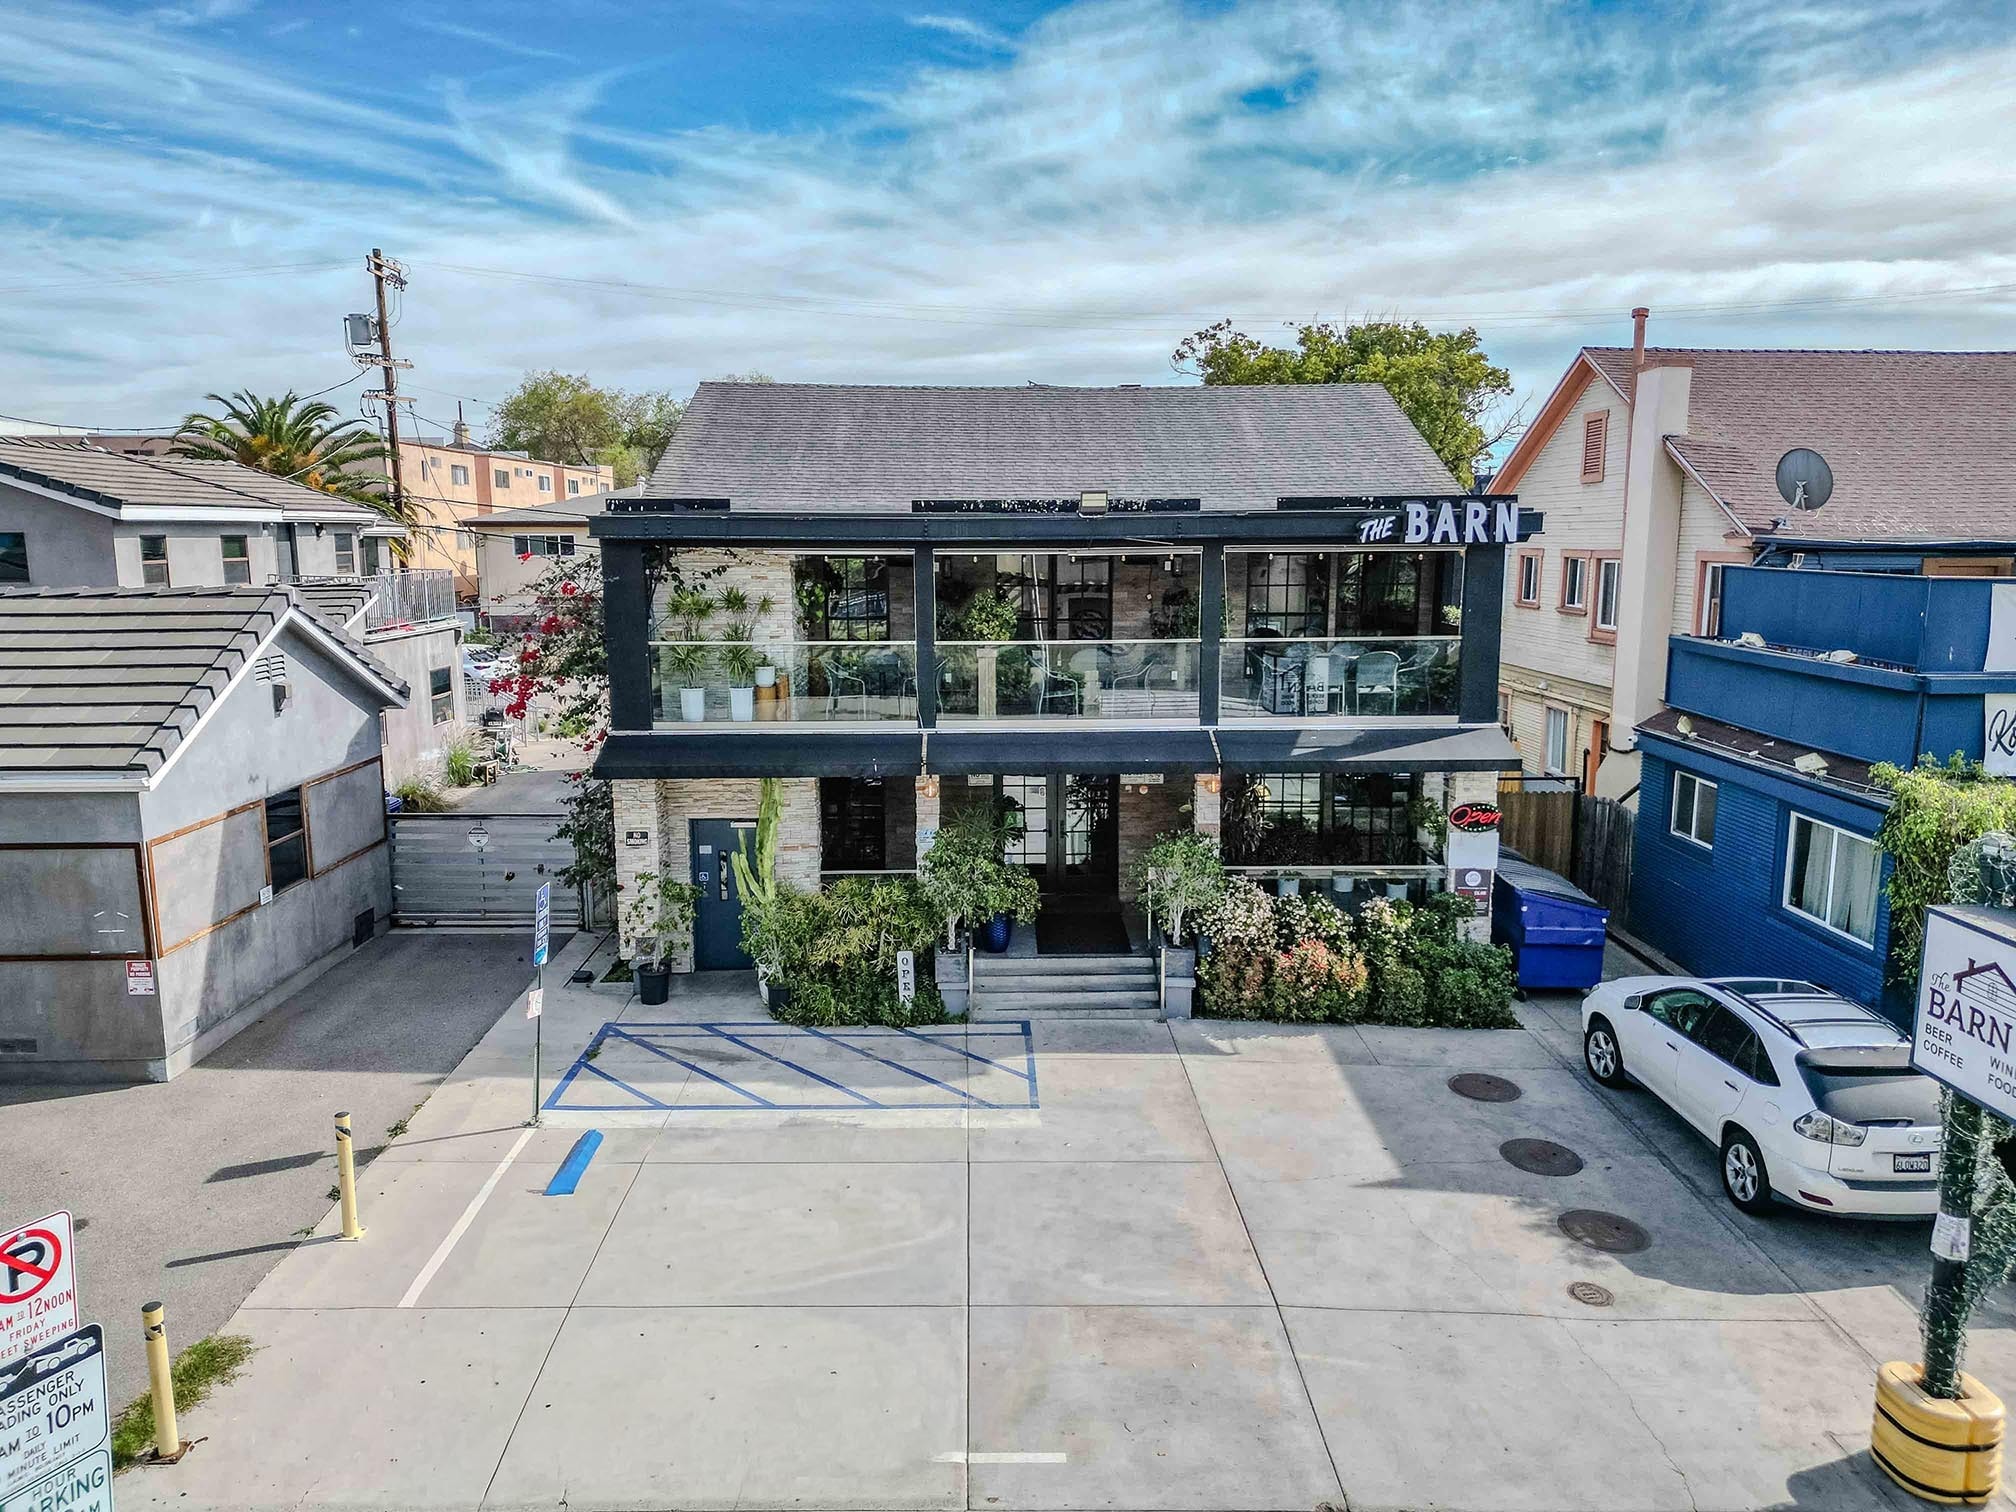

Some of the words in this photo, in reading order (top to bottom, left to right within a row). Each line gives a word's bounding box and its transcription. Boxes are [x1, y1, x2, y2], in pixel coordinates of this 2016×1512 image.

[1360, 515, 1396, 543] THE
[1404, 502, 1519, 544] BARN
[1450, 806, 1503, 826] Open
[1932, 971, 1951, 992] The
[1925, 1023, 1953, 1046] BEER
[1927, 987, 2013, 1054] BARN
[1923, 1039, 1964, 1069] COFFEE
[17, 1310, 25, 1321] TO
[9, 1318, 46, 1342] FRIDAY
[24, 1318, 74, 1347] SWEEPING
[49, 1378, 84, 1406] ONLY
[25, 1425, 41, 1441] TO
[46, 1398, 94, 1434] 10PM
[7, 1452, 48, 1478] MINUTE
[53, 1432, 81, 1454] LIMIT
[23, 1441, 46, 1460] DAILY
[32, 1468, 76, 1501] HOUR
